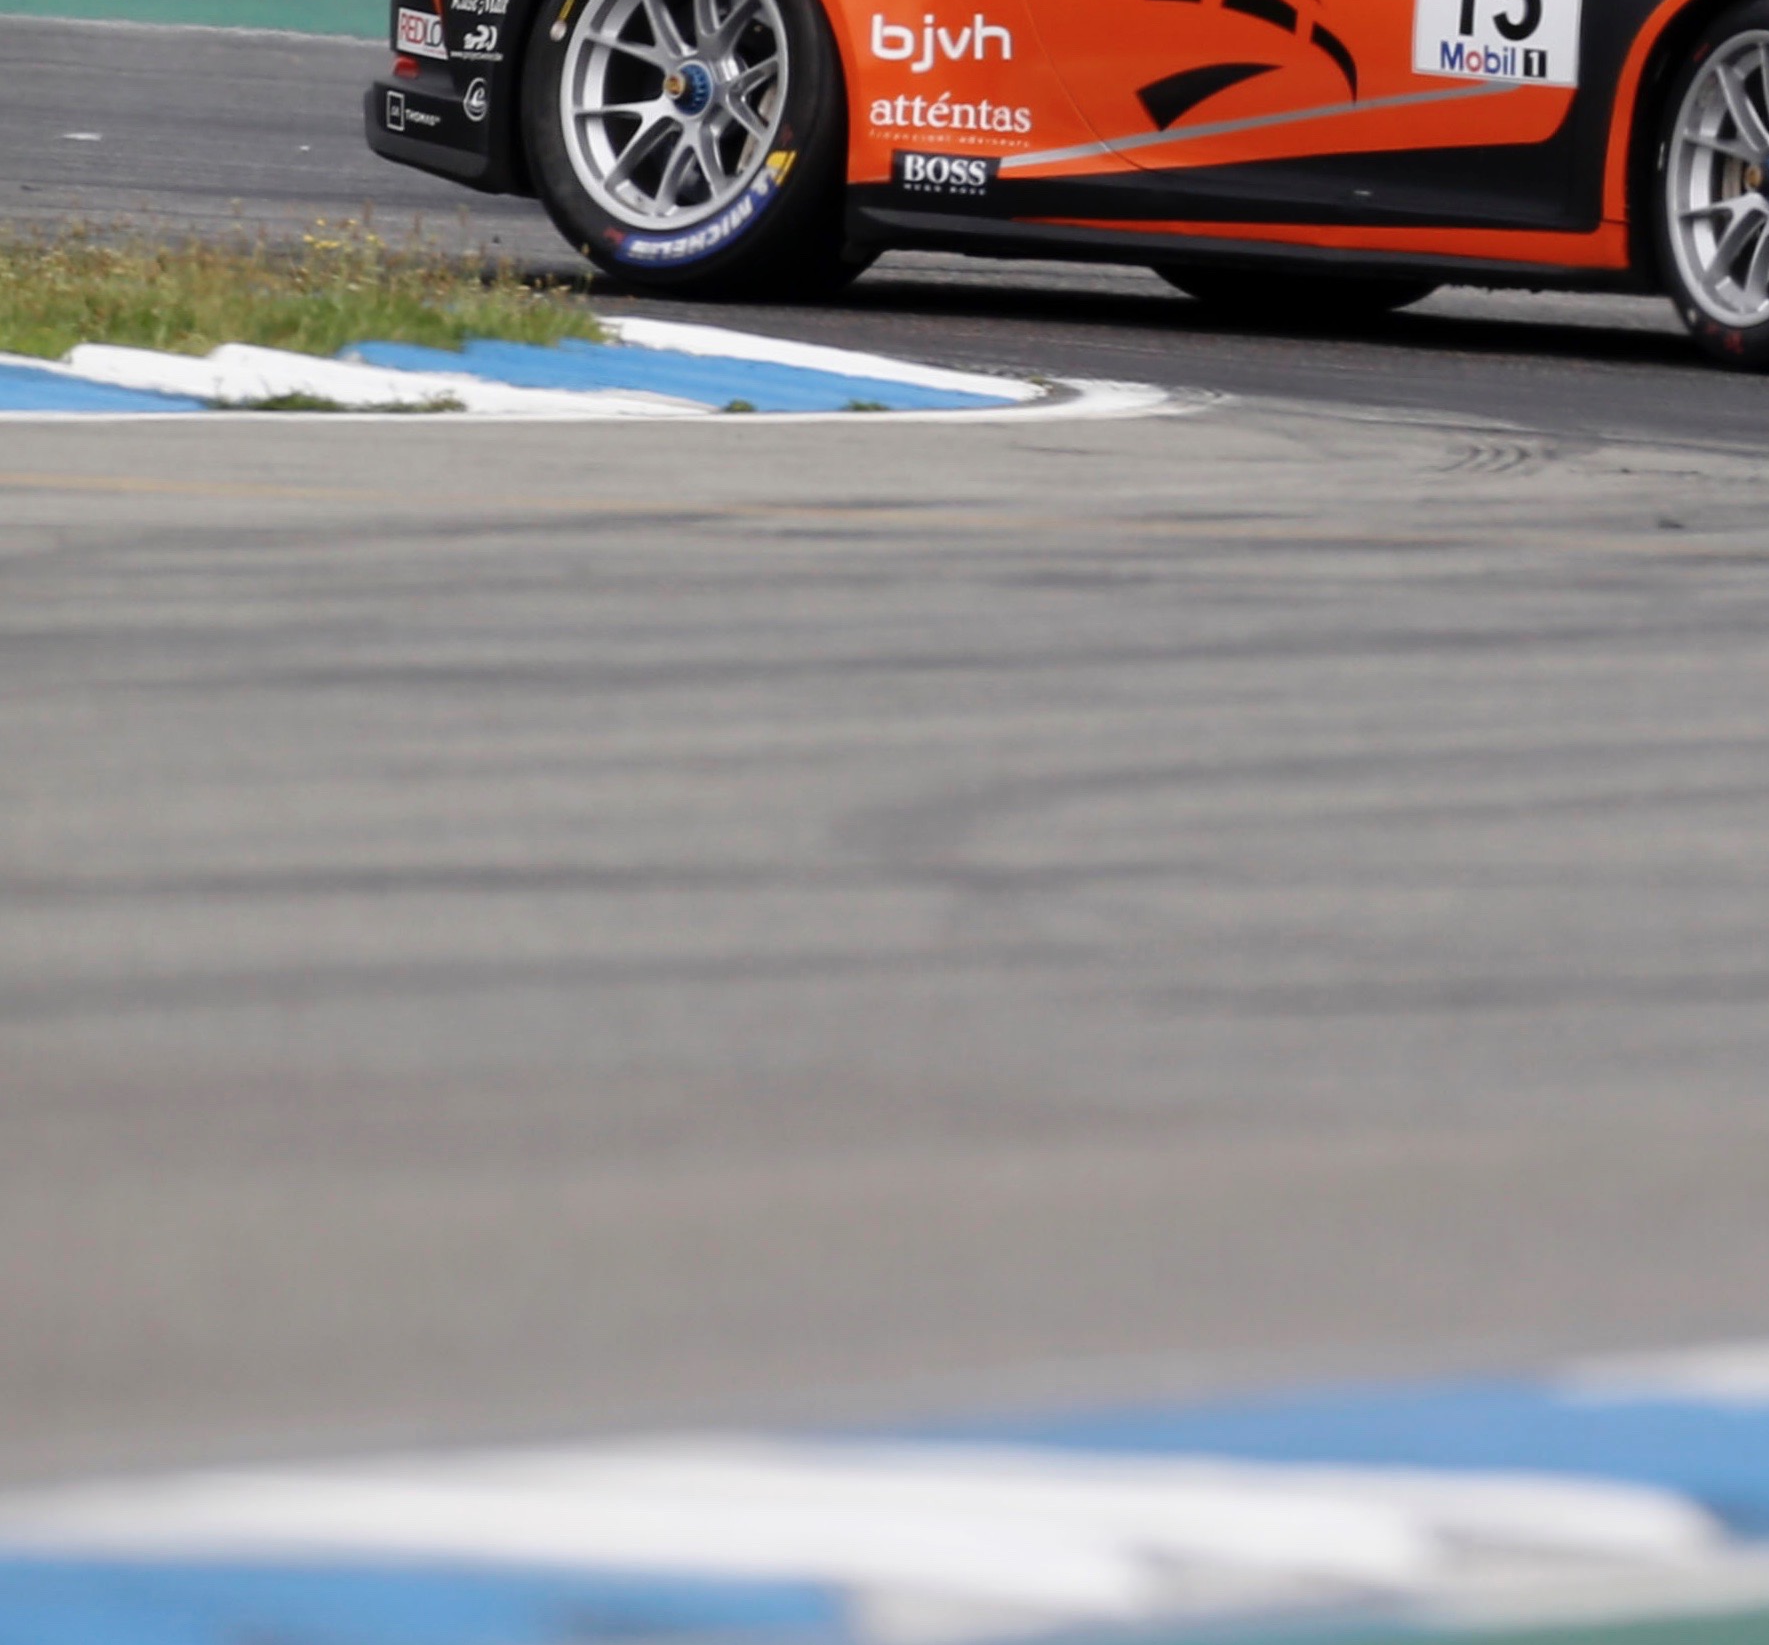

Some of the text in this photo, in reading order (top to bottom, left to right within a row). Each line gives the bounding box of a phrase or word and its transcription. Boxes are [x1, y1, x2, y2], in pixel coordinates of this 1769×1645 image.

[870, 13, 1013, 74] bjvh
[1440, 40, 1548, 79] Mobil 1
[868, 91, 1033, 133] atténtas
[903, 153, 987, 187] BOSS
[626, 194, 754, 261] MICHELIN
